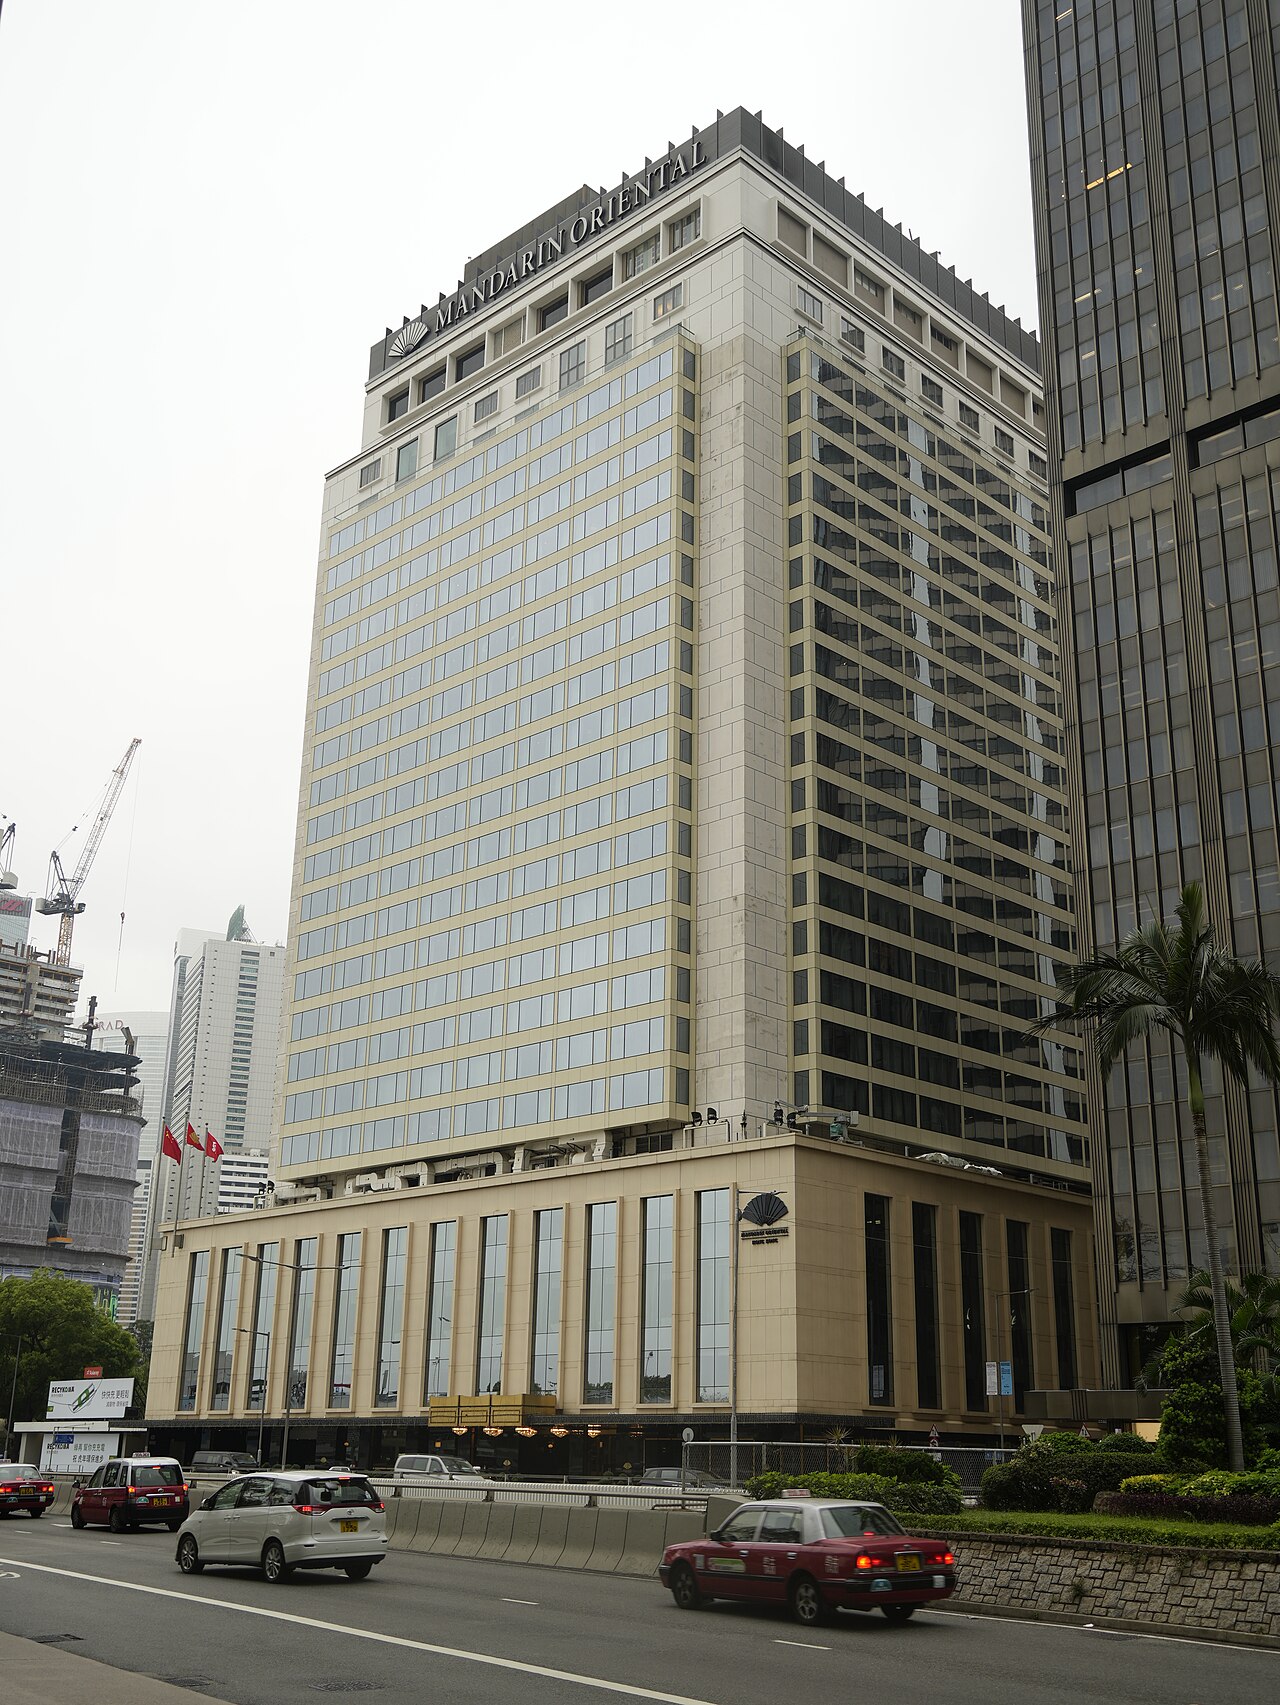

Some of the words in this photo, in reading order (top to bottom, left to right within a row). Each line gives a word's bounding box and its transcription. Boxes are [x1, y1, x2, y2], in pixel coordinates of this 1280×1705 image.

[435, 228, 566, 333] MANDARIN
[569, 141, 707, 244] ORIENTAL
[98, 1020, 124, 1031] RAD
